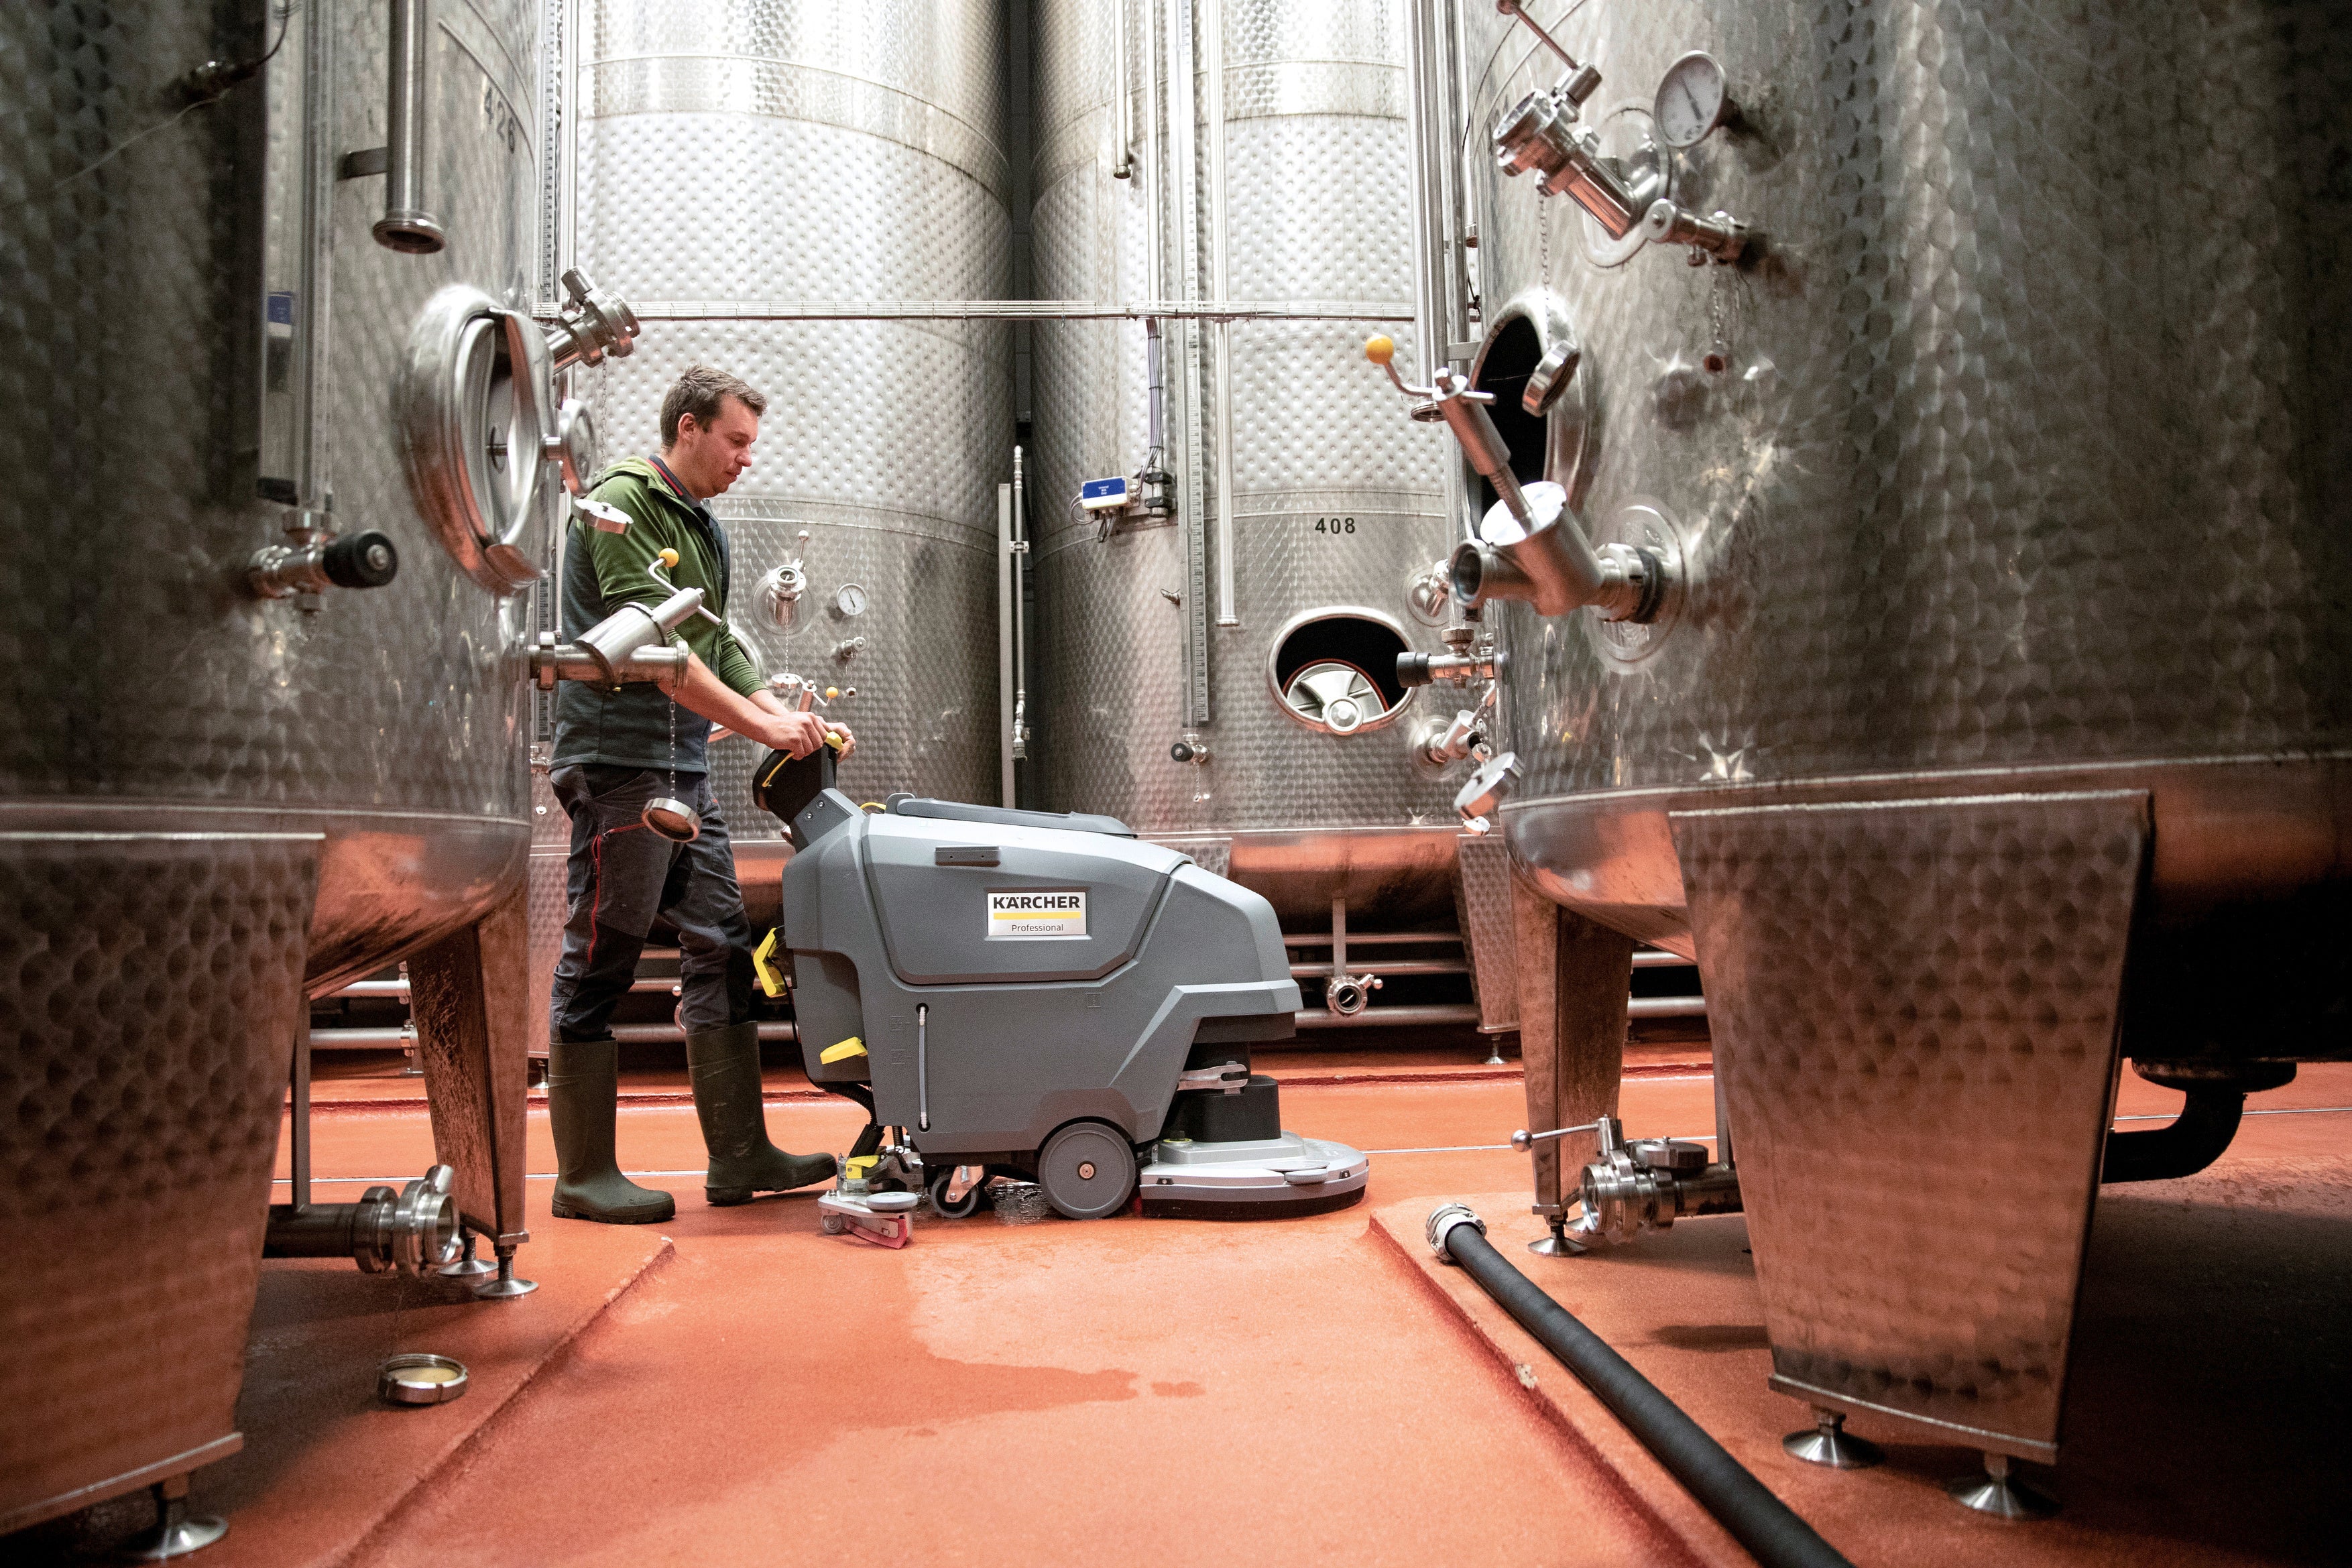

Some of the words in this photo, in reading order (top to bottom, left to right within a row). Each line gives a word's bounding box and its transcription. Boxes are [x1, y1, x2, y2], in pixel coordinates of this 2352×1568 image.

[484, 86, 516, 154] 426
[1315, 518, 1355, 534] 408
[994, 896, 1080, 909] KÄRCHER
[1012, 924, 1063, 932] Professional
